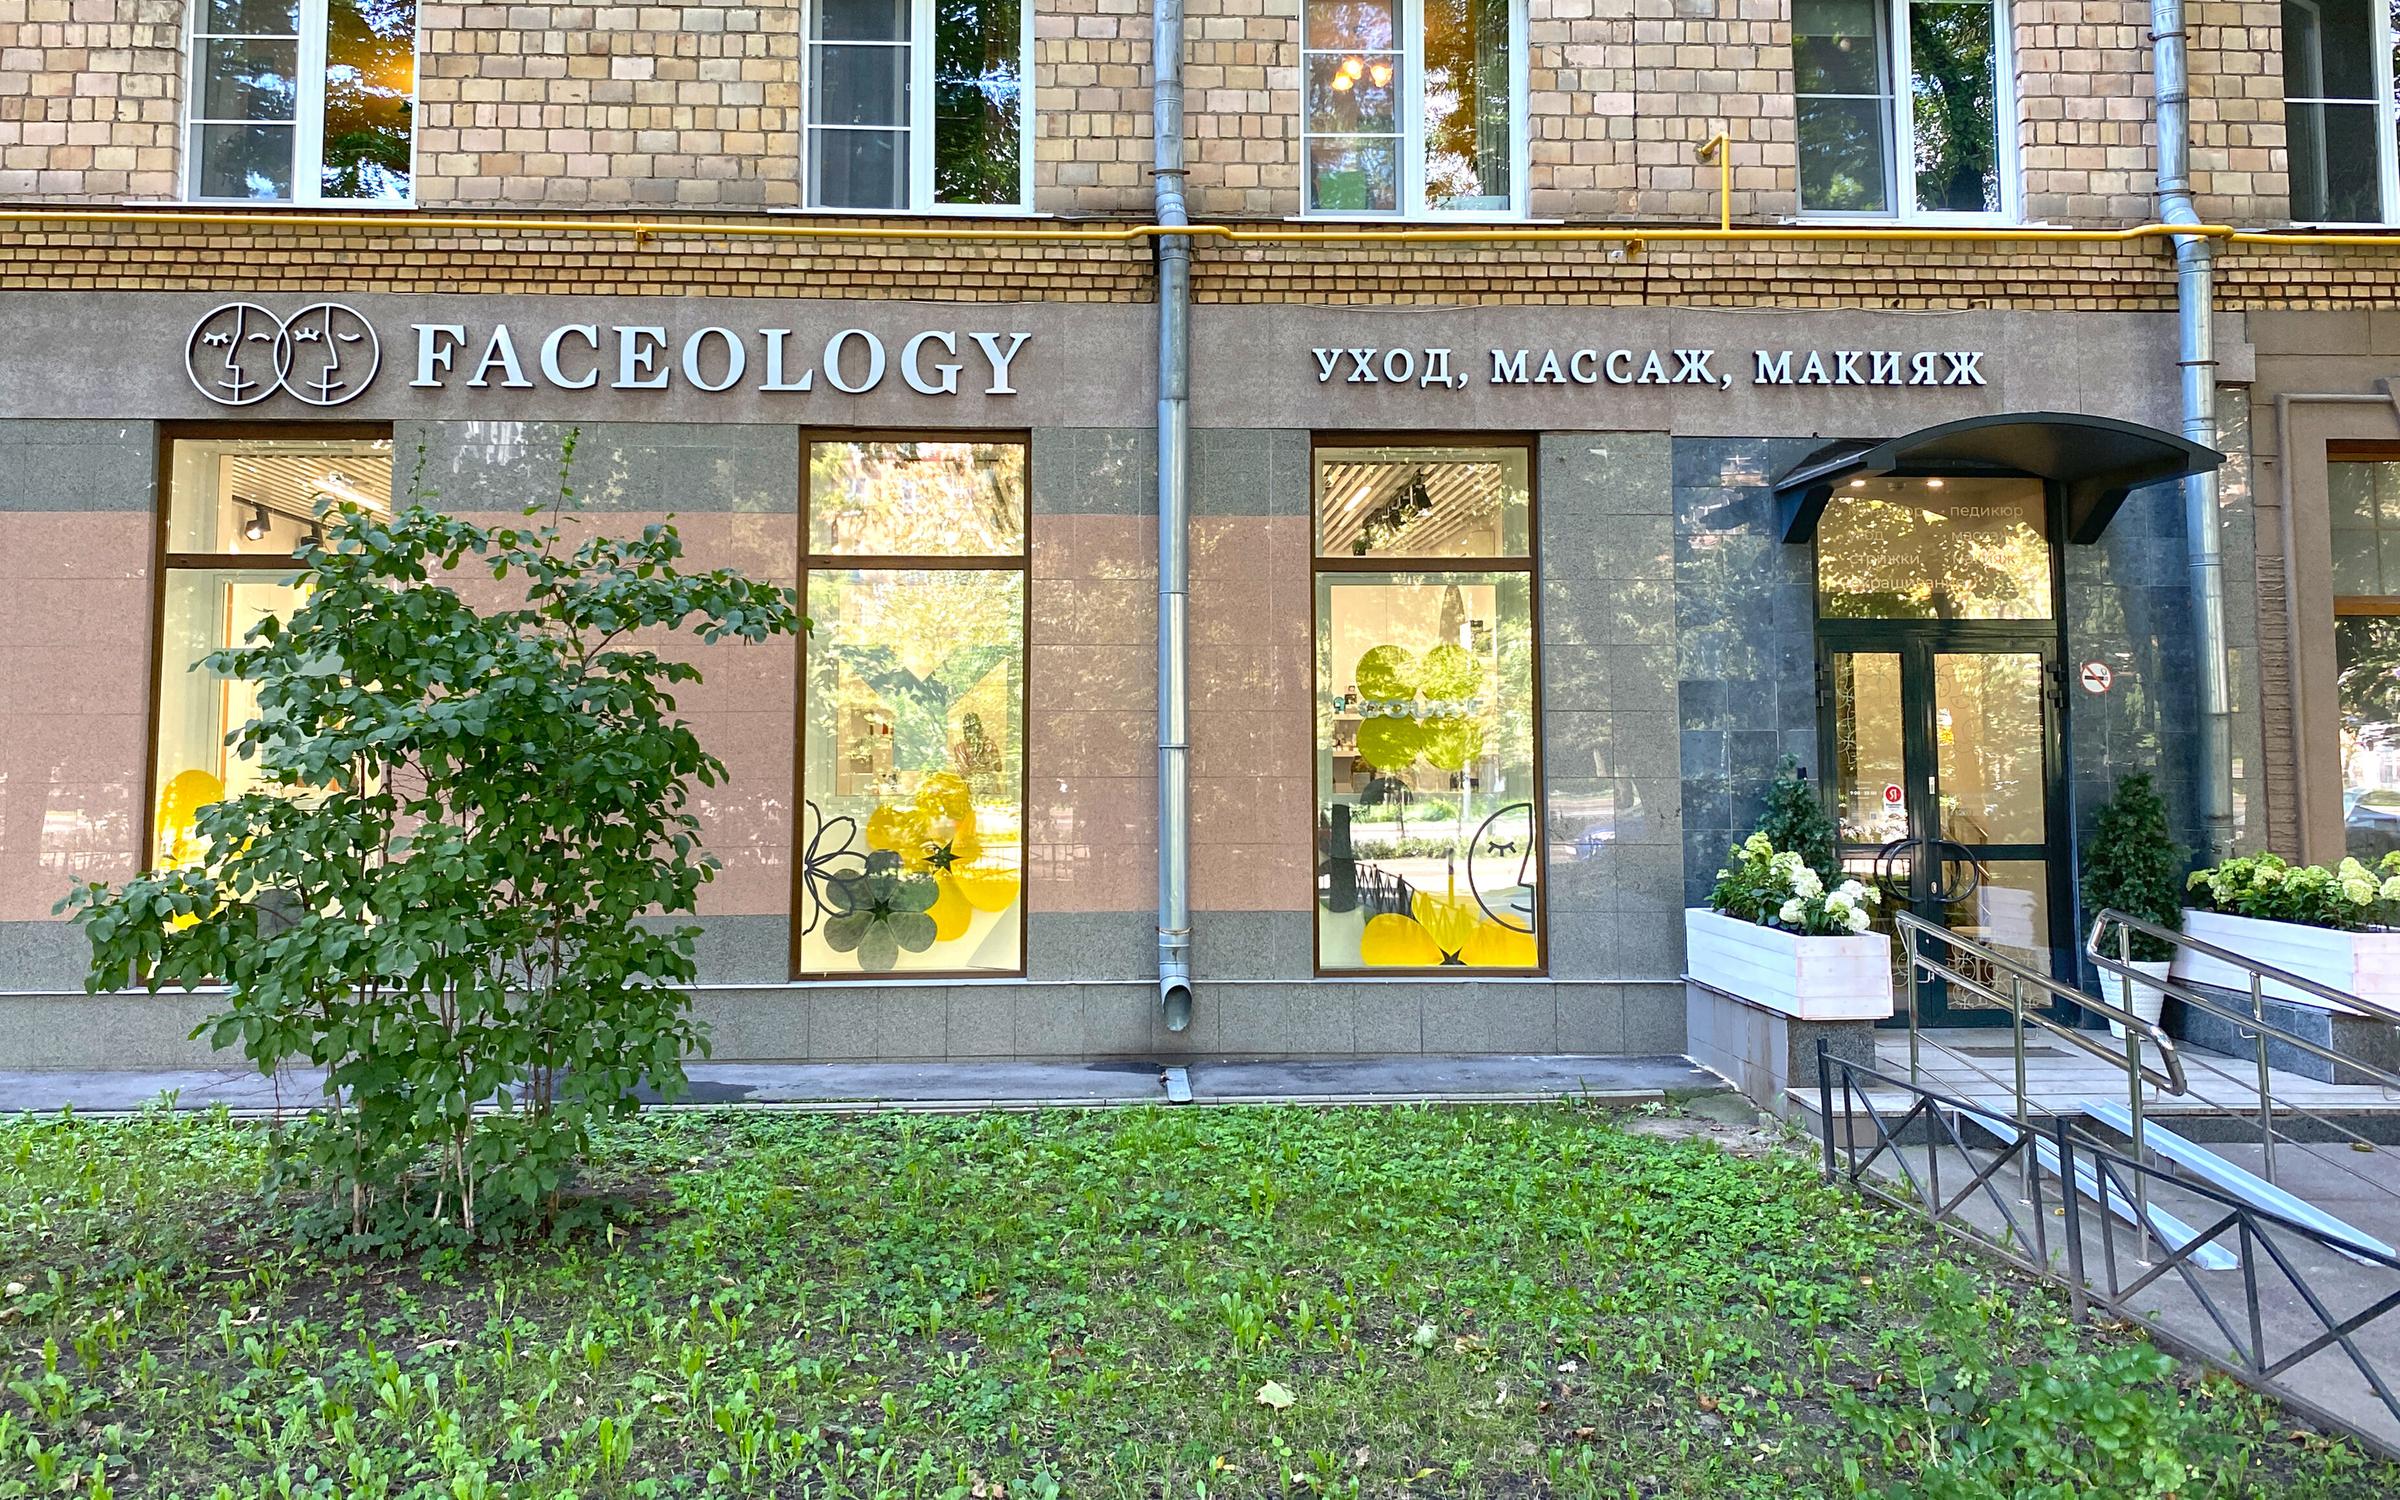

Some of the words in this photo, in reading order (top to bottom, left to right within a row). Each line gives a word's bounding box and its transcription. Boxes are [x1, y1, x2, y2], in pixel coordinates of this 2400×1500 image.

[409, 323, 1032, 395] FACEOLOGY
[1312, 348, 1470, 390] УХОД,
[1491, 348, 1732, 391] МАССАЖ,
[1754, 350, 1987, 387] МАКИЯЖ
[1950, 506, 2023, 519] педикюр
[1849, 555, 1920, 567] стрижки
